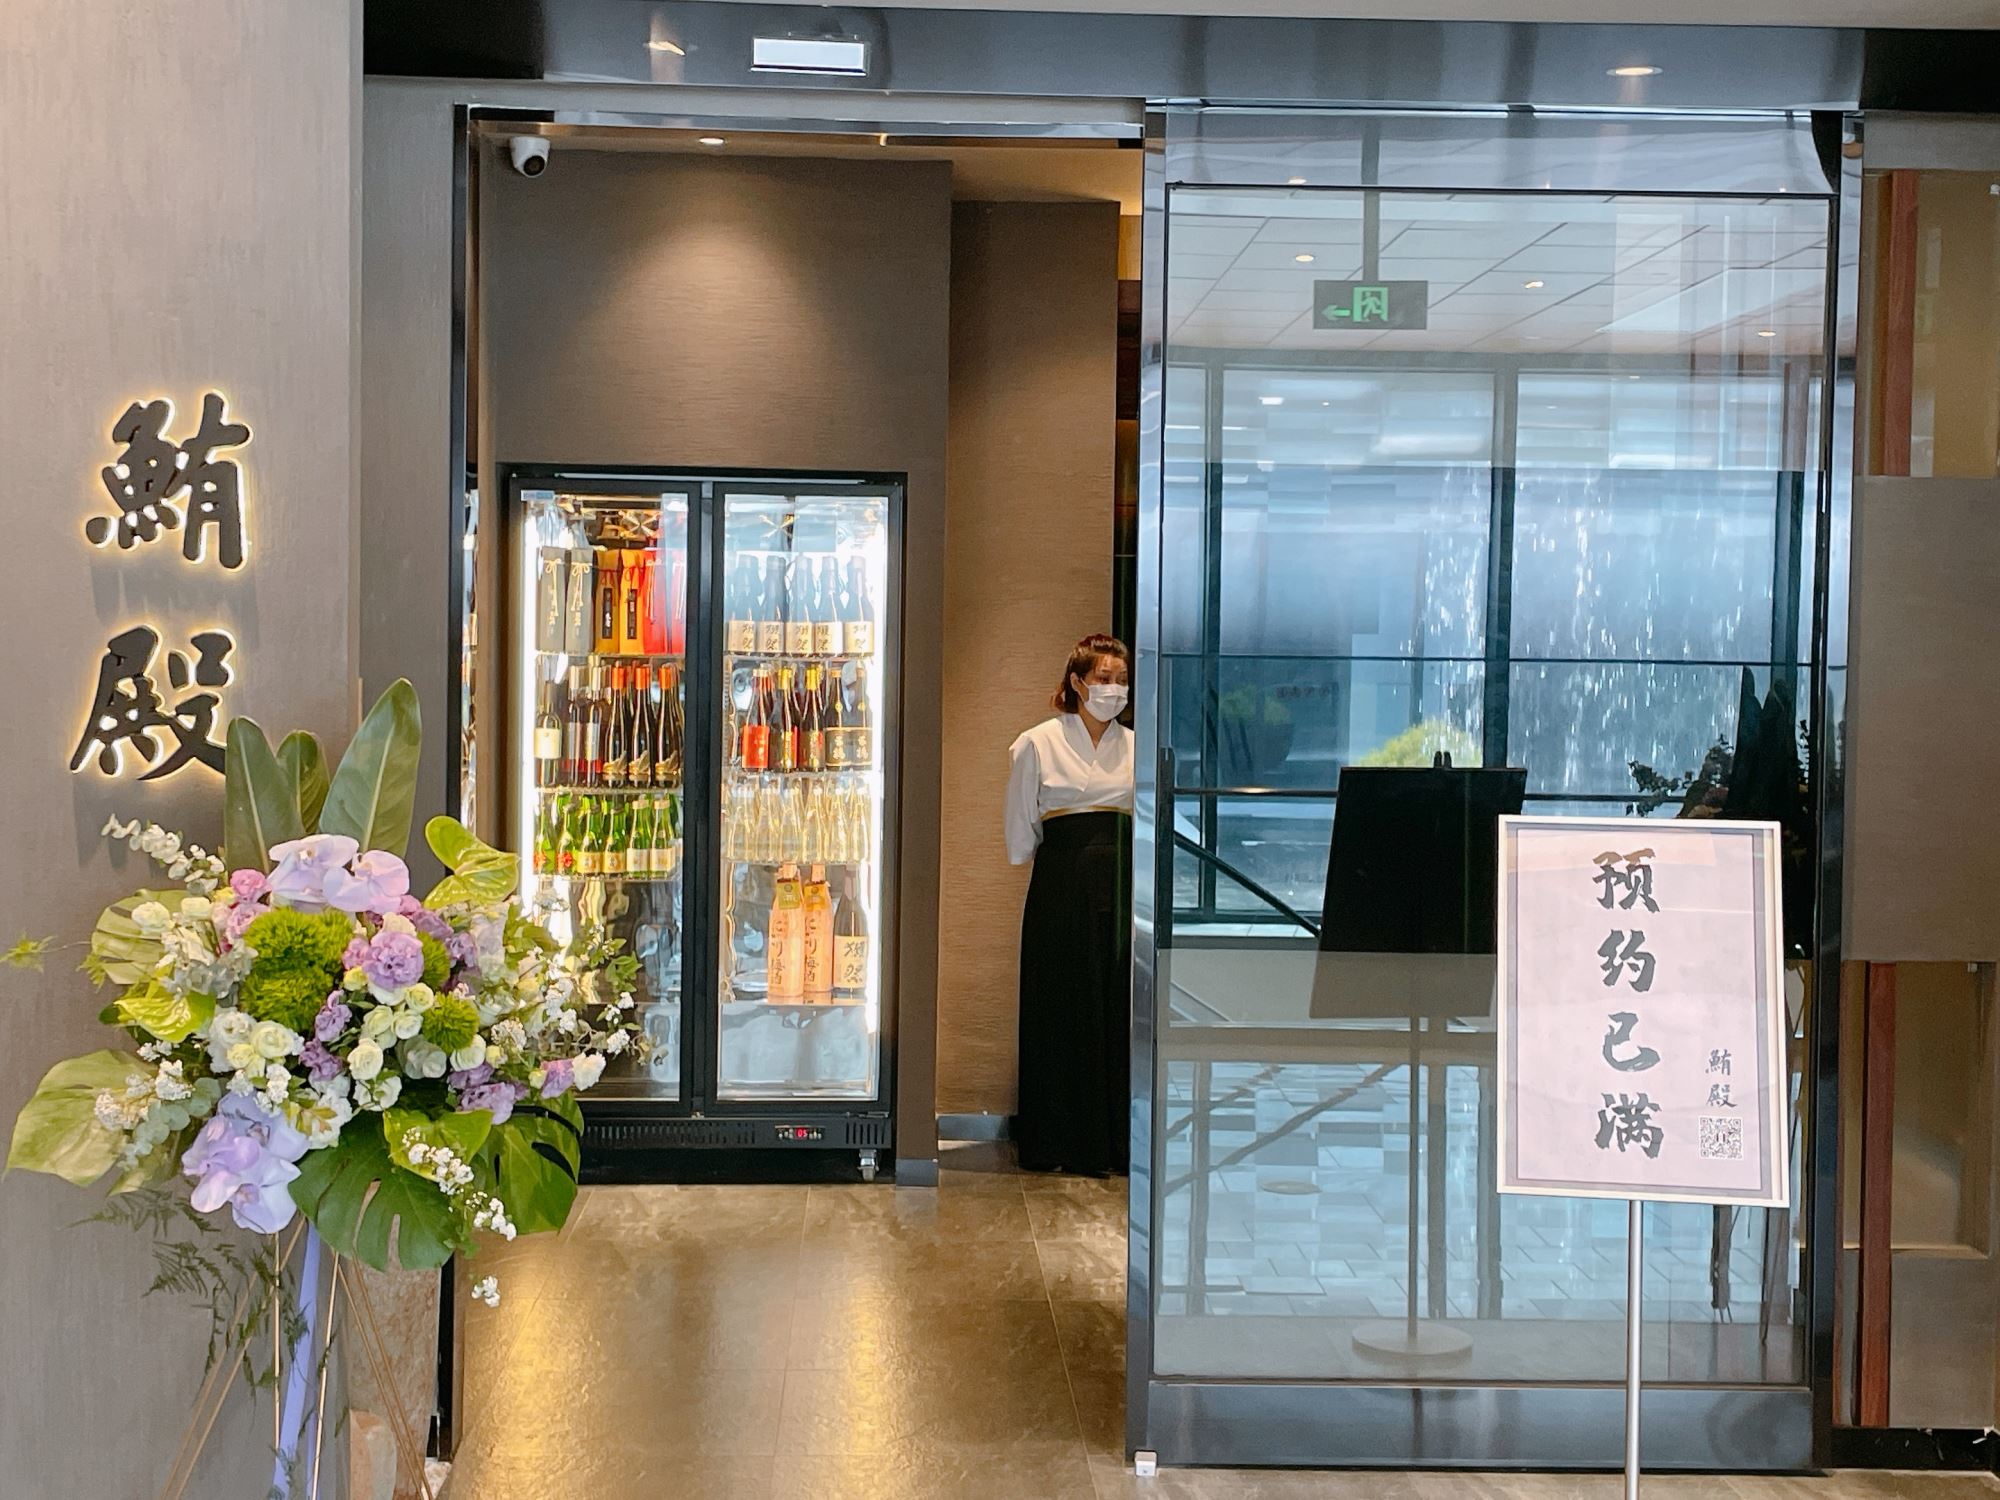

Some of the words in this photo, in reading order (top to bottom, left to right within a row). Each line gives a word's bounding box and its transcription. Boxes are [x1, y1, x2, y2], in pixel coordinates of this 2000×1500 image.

[71, 393, 250, 780] 鮪殿
[1592, 847, 1664, 1160] 预约已满
[1705, 1048, 1738, 1108] 鮪殿
